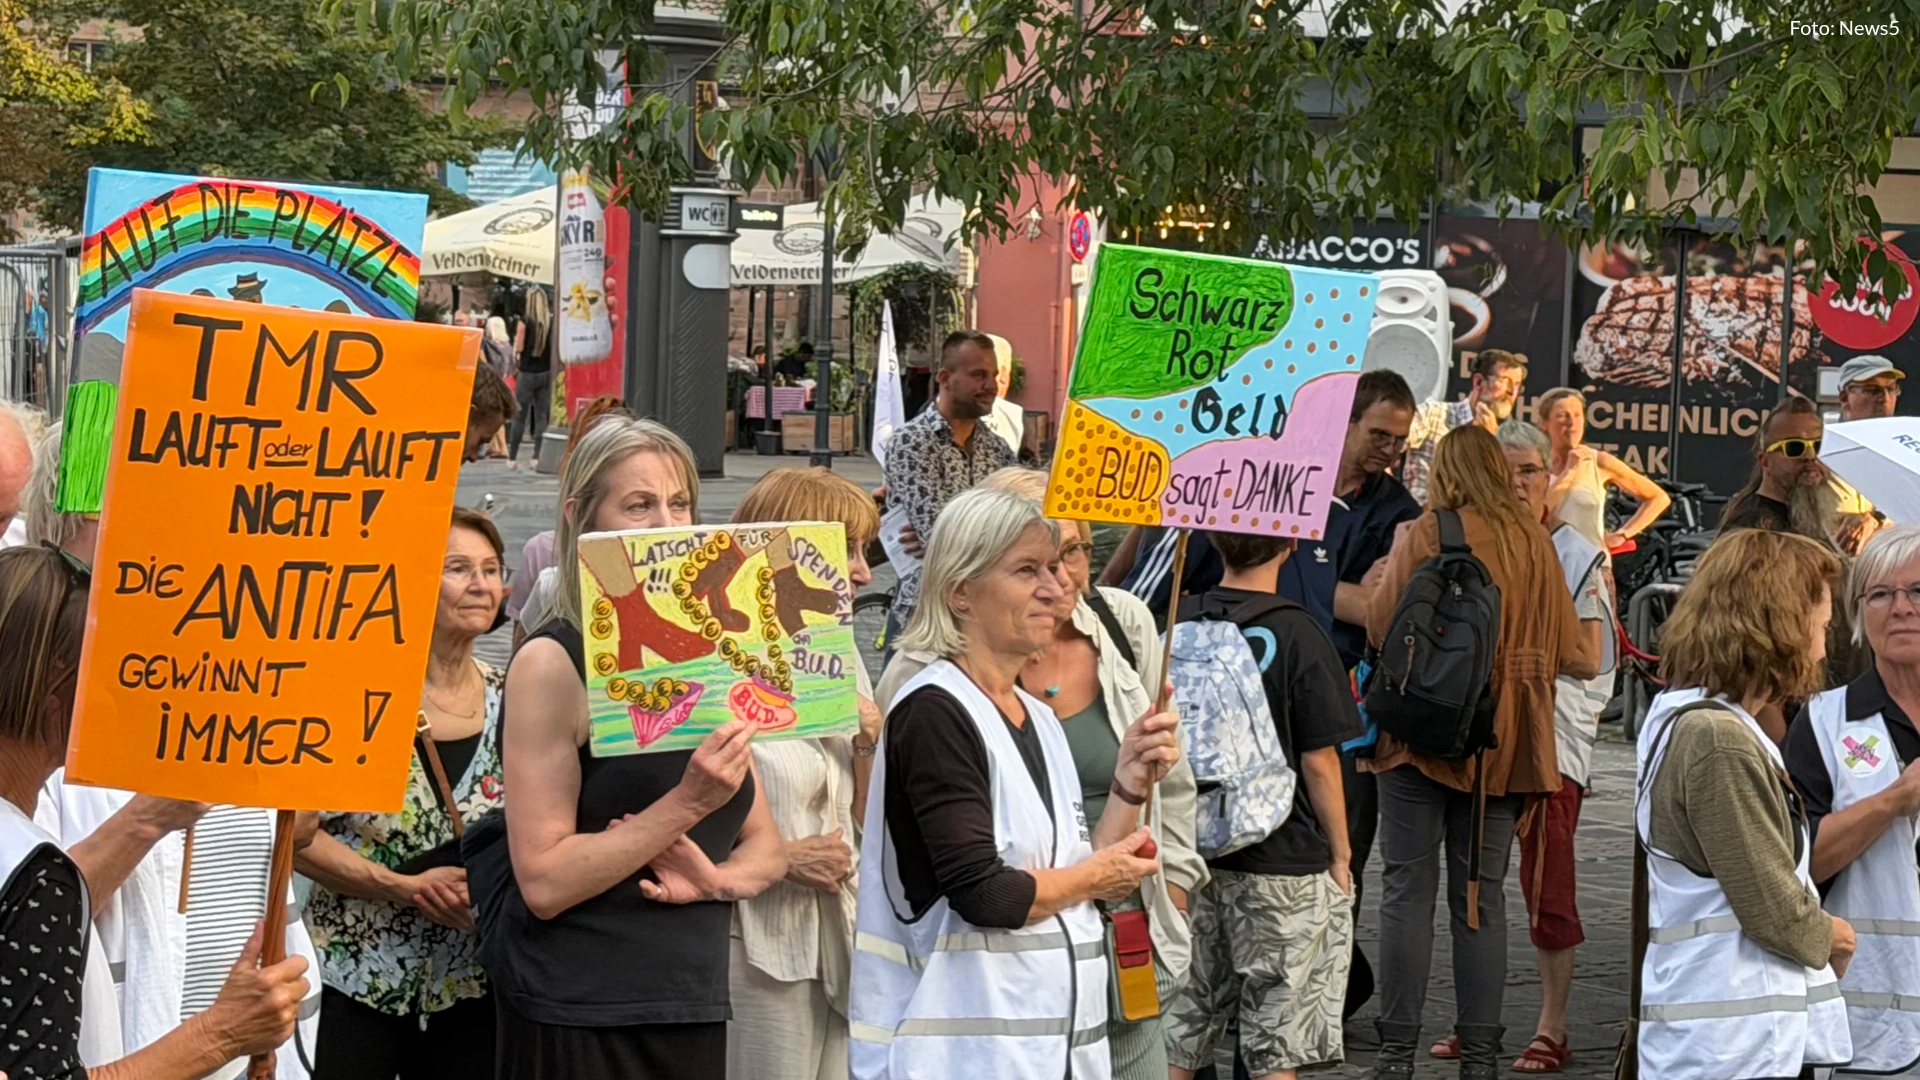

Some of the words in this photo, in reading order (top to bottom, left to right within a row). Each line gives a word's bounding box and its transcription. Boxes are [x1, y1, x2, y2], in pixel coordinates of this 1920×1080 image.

[100, 190, 183, 299] AUF
[199, 182, 256, 244] DIE
[267, 188, 414, 299] PLÄTZE
[688, 206, 710, 222] WC
[731, 263, 850, 281] Veldensteier
[1129, 267, 1285, 332] Schwarz
[173, 312, 384, 415] TMR
[1166, 327, 1236, 382] Rot
[1191, 386, 1288, 441] Geld
[127, 408, 282, 471] LAUFT
[263, 433, 313, 460] oder
[314, 426, 462, 481] LAUFT
[1892, 434, 1920, 454] RE
[1165, 458, 1232, 524] sagt
[1232, 458, 1323, 516] DANKE
[631, 531, 708, 567] LATSCHT
[737, 530, 774, 548] FÜR
